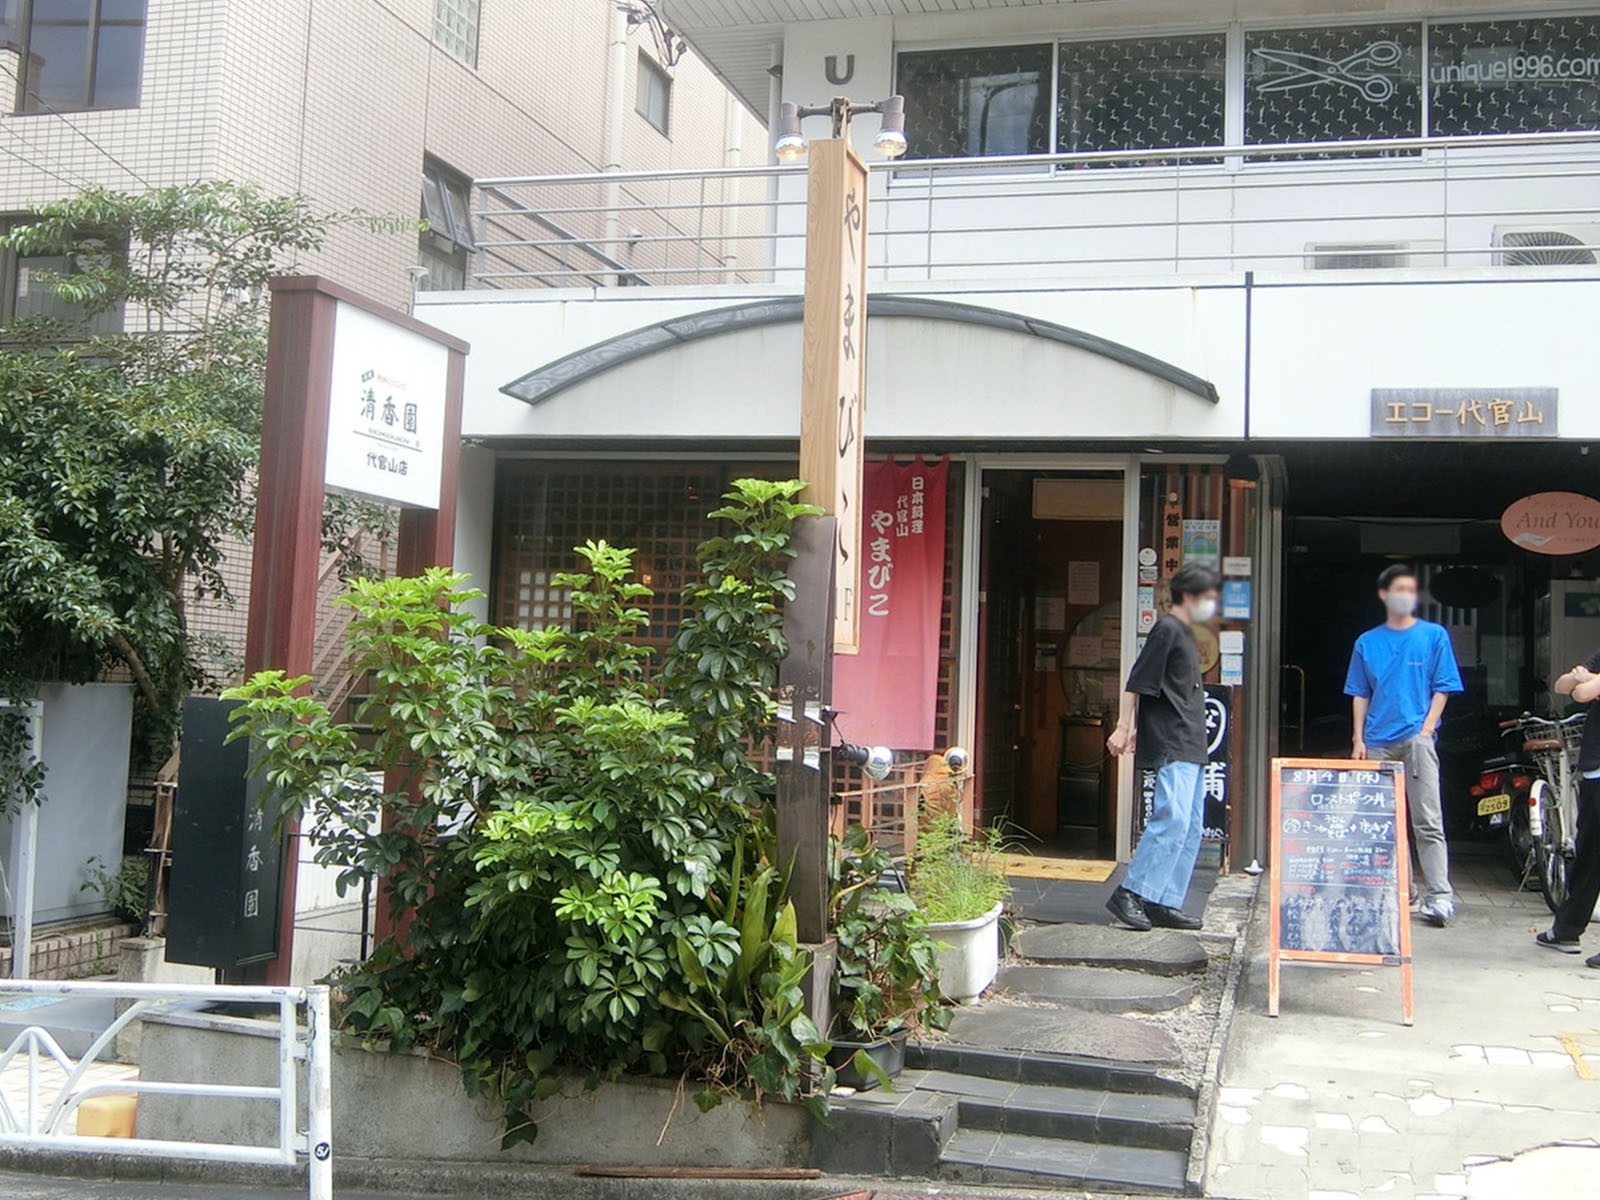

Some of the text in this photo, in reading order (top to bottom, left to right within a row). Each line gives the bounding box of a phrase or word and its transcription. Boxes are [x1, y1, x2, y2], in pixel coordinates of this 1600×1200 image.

[360, 387, 418, 435] 清香園
[1384, 397, 1545, 426] エコー代官山
[366, 451, 409, 476] 代官山店
[895, 494, 909, 537] 代官山
[911, 476, 925, 535] 日本料理
[1515, 511, 1600, 529] And You
[867, 509, 894, 617] やまびこ
[1165, 512, 1181, 573] 営業中
[243, 807, 264, 919] 清香園
